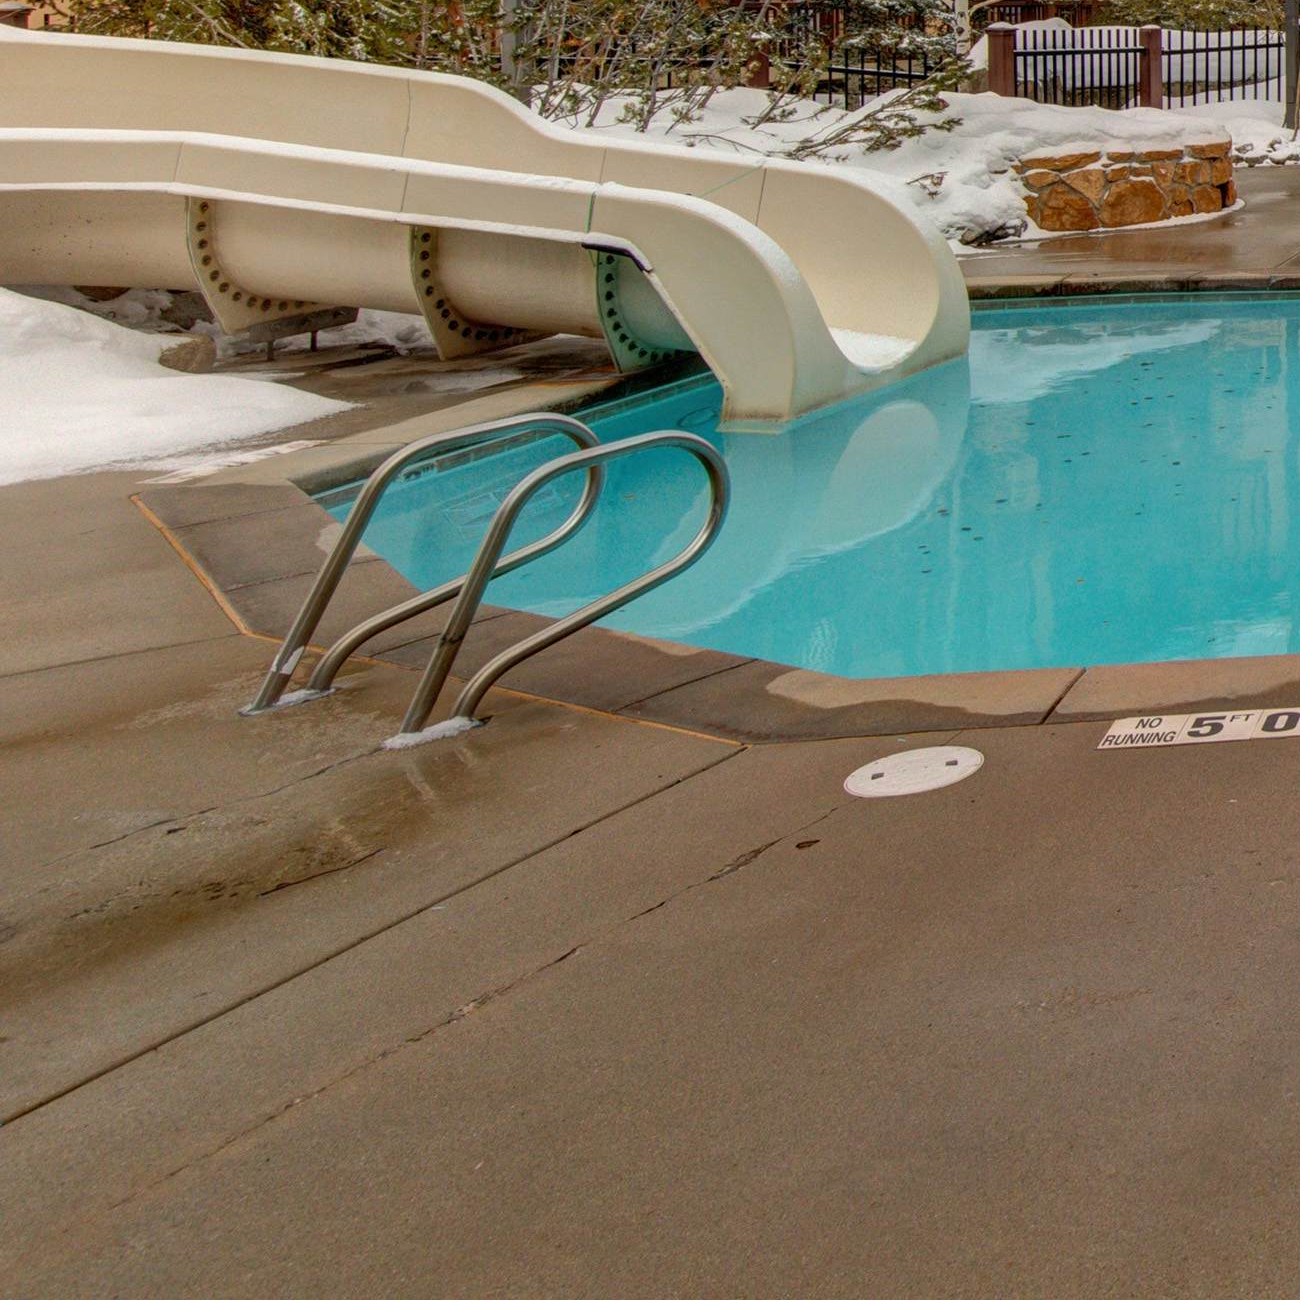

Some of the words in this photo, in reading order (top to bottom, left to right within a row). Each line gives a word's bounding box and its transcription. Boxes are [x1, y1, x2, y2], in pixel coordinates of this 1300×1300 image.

[1135, 717, 1162, 729] NO
[1187, 715, 1227, 738] 5
[1230, 714, 1255, 722] FT
[1101, 731, 1177, 747] RUNNING
